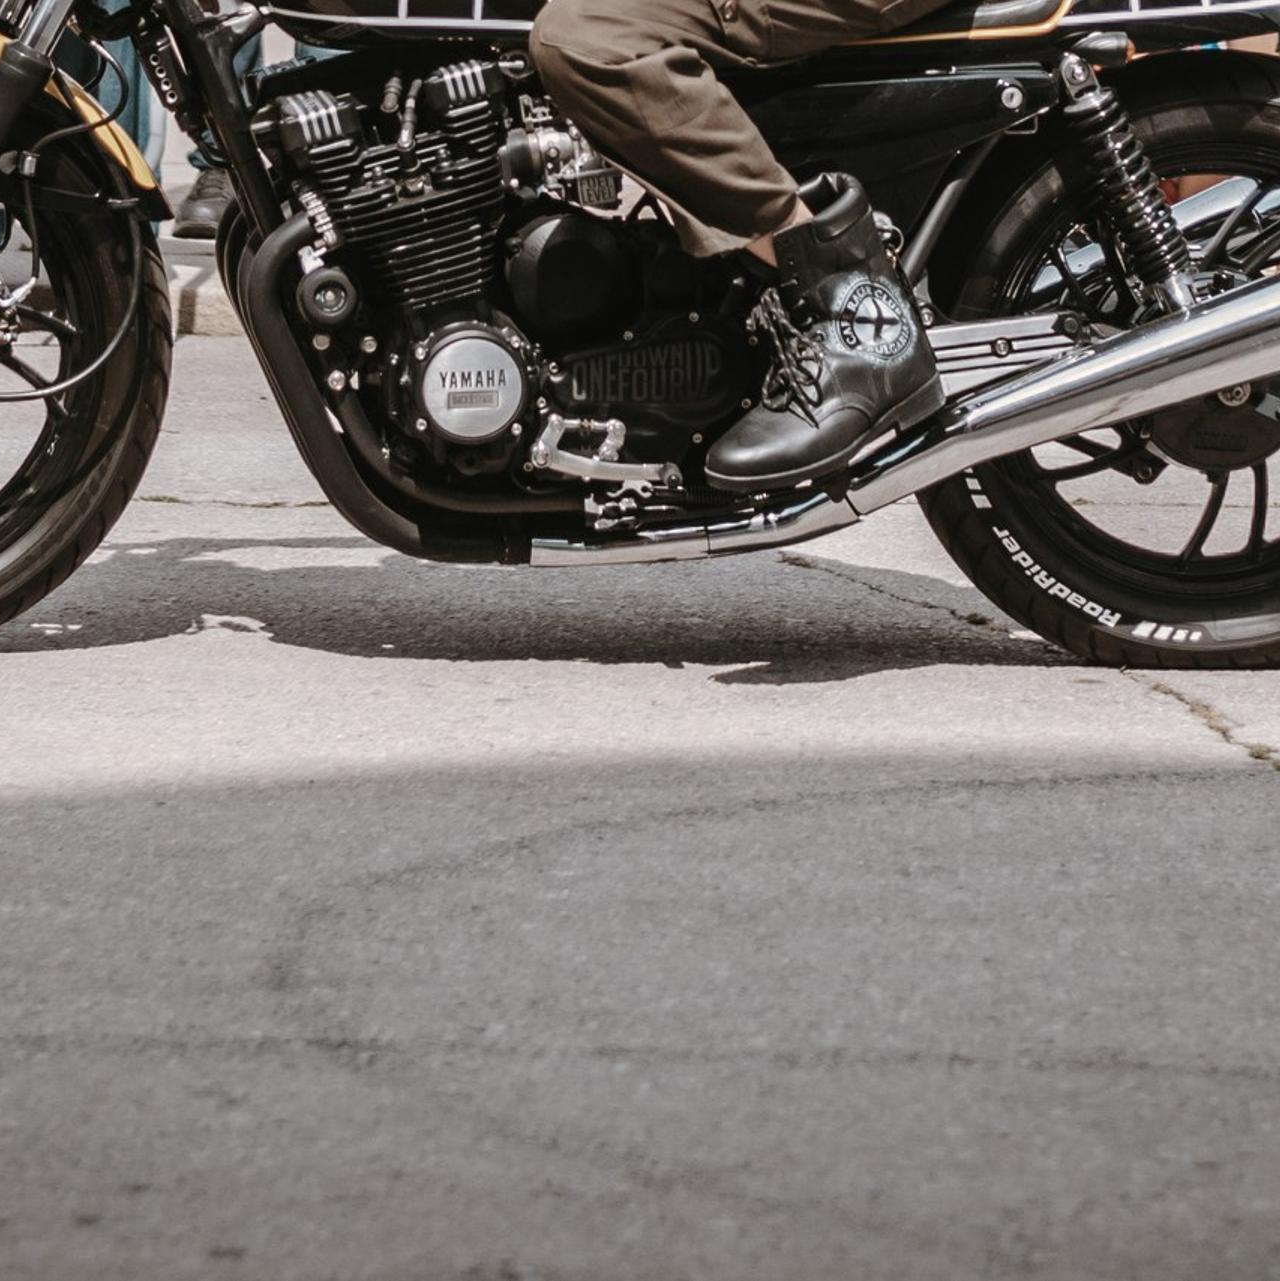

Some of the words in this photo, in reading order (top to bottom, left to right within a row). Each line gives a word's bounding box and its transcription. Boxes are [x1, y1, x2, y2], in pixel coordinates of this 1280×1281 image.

[439, 368, 507, 389] YAMAHA
[572, 355, 618, 402] ONE
[991, 525, 1123, 628] RoadRider
